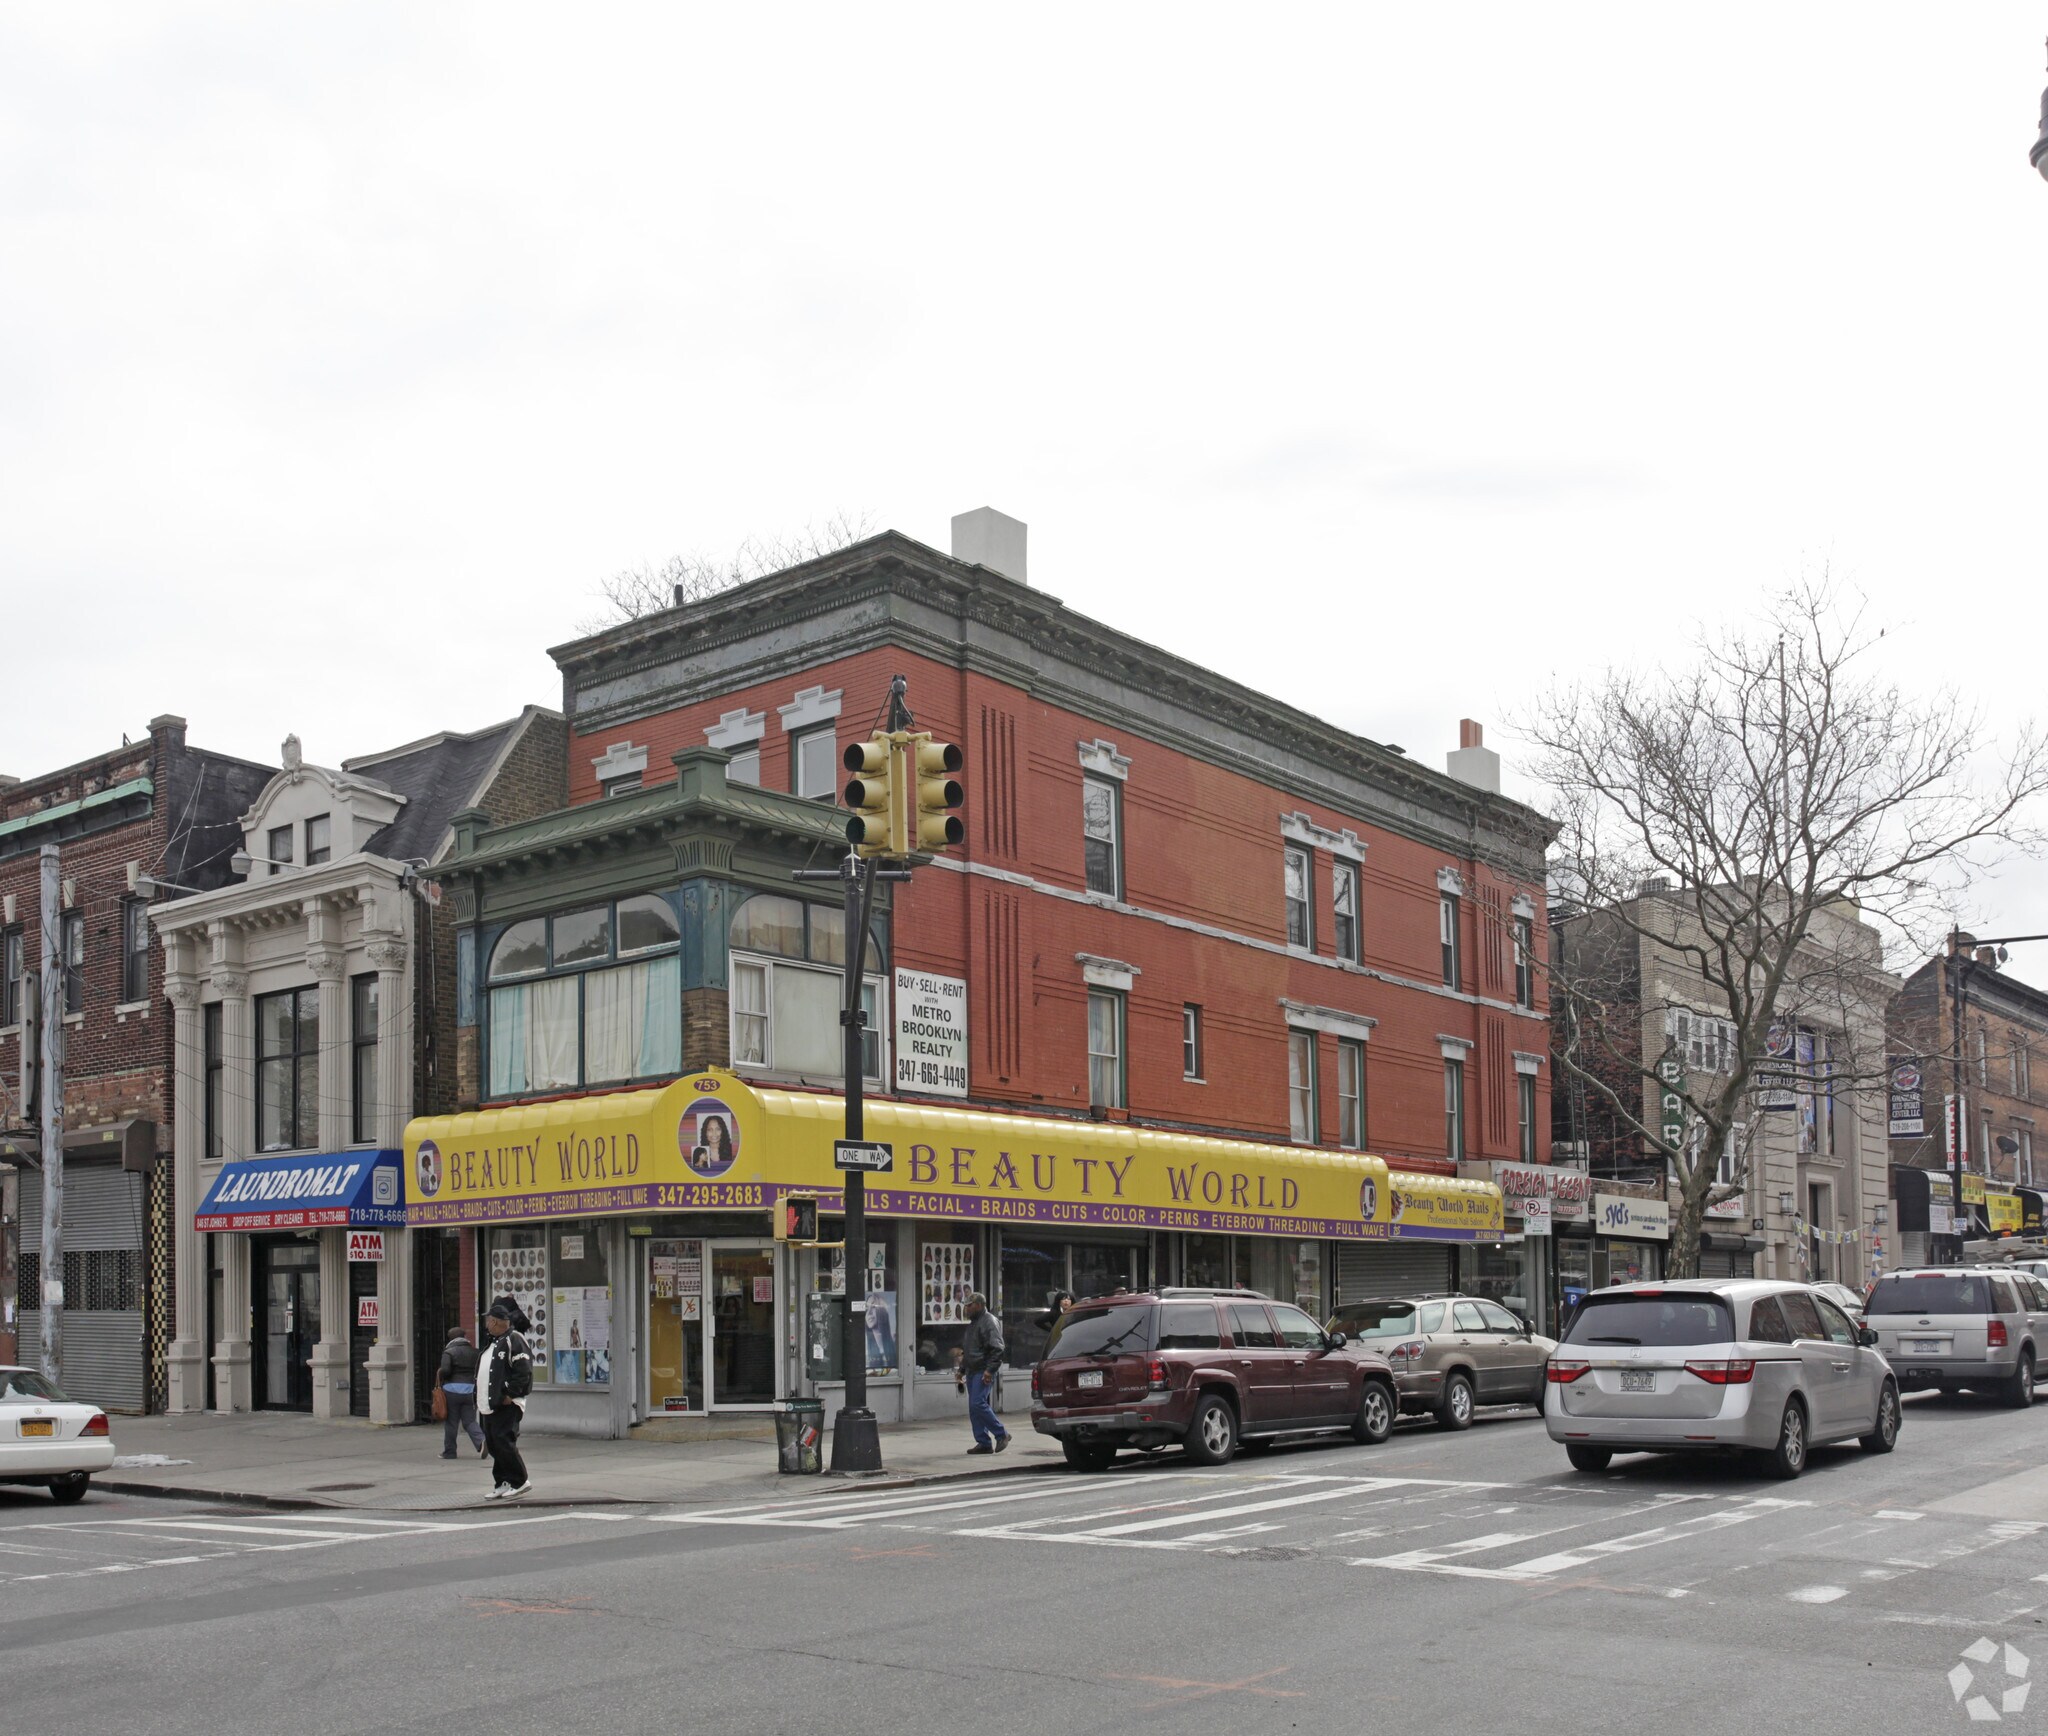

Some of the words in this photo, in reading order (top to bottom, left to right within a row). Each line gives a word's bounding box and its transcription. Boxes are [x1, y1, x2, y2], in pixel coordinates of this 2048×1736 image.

[898, 975, 915, 990] BUY
[920, 978, 938, 994] SELL
[943, 983, 963, 998] RENT
[924, 996, 938, 1004] WITH
[912, 1004, 951, 1022] METRO
[902, 1020, 961, 1041] BROOKLYN
[912, 1040, 952, 1058] REALTY
[899, 1058, 965, 1088] 347-663-4449
[697, 1080, 717, 1090] 753
[450, 1134, 541, 1193] BEAUTY
[557, 1130, 640, 1183] WORLD
[842, 1150, 859, 1161] ONE
[869, 1151, 886, 1163] WAY
[213, 1163, 360, 1203] LAUNDROMAT
[908, 1143, 1135, 1198] BEAUTY
[1166, 1161, 1299, 1210] WORLD
[1502, 1168, 1547, 1198] FOREIGN
[407, 1206, 419, 1221] HAIR
[423, 1205, 438, 1220] NAILS
[443, 1203, 460, 1219] FACIAL
[464, 1202, 483, 1218] BRAIDS
[487, 1201, 501, 1216] CUTS
[505, 1199, 524, 1214] COLOR
[528, 1197, 547, 1213] PERMS
[551, 1194, 578, 1211] EYEBROW
[580, 1191, 612, 1208] THREADING
[617, 1189, 631, 1206] FULL
[632, 1187, 648, 1204] WAVE
[658, 1185, 763, 1205] 347-295-2683
[1404, 1193, 1434, 1213] Beauty
[1437, 1197, 1464, 1213] World
[1466, 1199, 1489, 1214] Nails
[209, 1216, 222, 1228] JOHNS
[222, 1216, 228, 1227] PL
[233, 1215, 244, 1226] DROP
[253, 1214, 271, 1226] SERVICE
[274, 1213, 283, 1225] DRY
[283, 1212, 303, 1224] CLEANER
[350, 1208, 407, 1222] 718-778-6666
[909, 1194, 963, 1214] FACIAL
[981, 1198, 1036, 1218] BRAIDS
[1052, 1203, 1087, 1219] CUTS
[1103, 1207, 1146, 1223] COLOR
[1160, 1211, 1199, 1227] PERMS
[1211, 1214, 1264, 1230] EYEBROW
[1268, 1217, 1325, 1234] THREADING
[1336, 1222, 1359, 1236] FULL
[1361, 1223, 1385, 1237] WAVE
[1470, 1217, 1484, 1226] Salon
[350, 1234, 382, 1249] ATM
[350, 1250, 366, 1259] $10.
[367, 1251, 382, 1259] Bills
